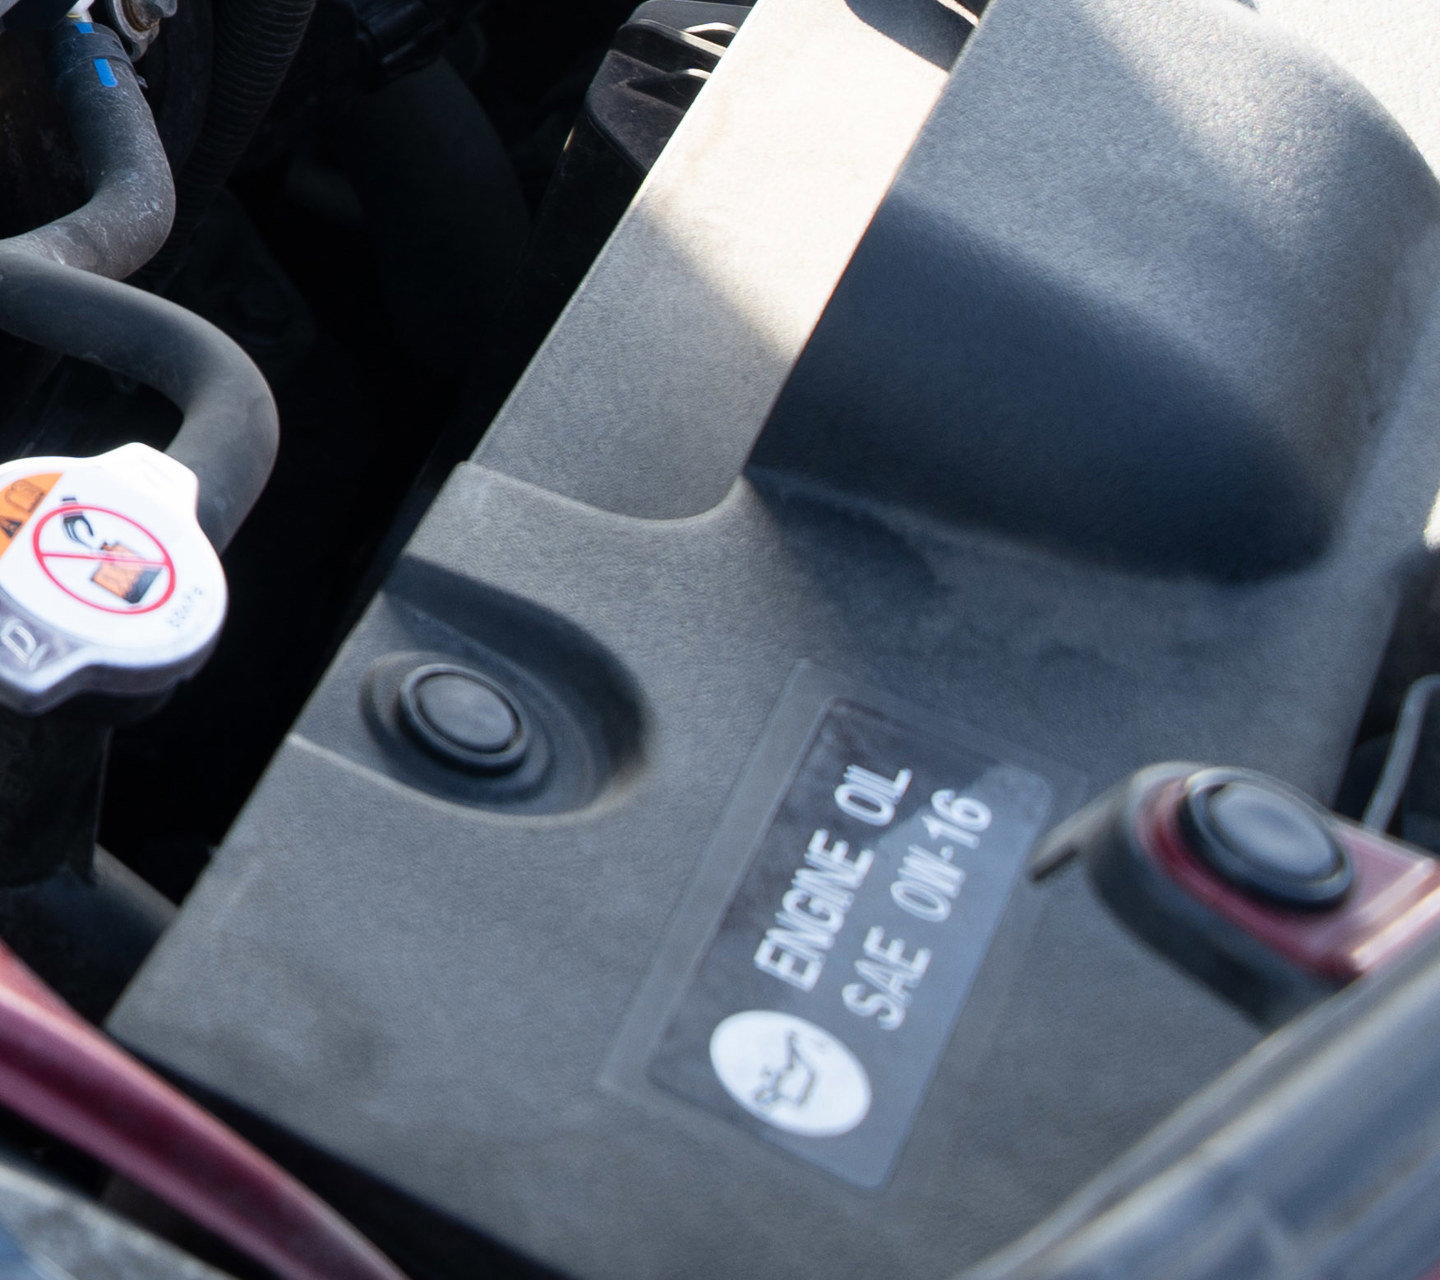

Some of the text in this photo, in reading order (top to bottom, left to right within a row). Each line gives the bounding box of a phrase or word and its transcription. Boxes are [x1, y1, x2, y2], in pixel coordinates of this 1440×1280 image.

[754, 763, 912, 991] ENGINE OIL
[841, 788, 992, 1031] SAE 0W-16
